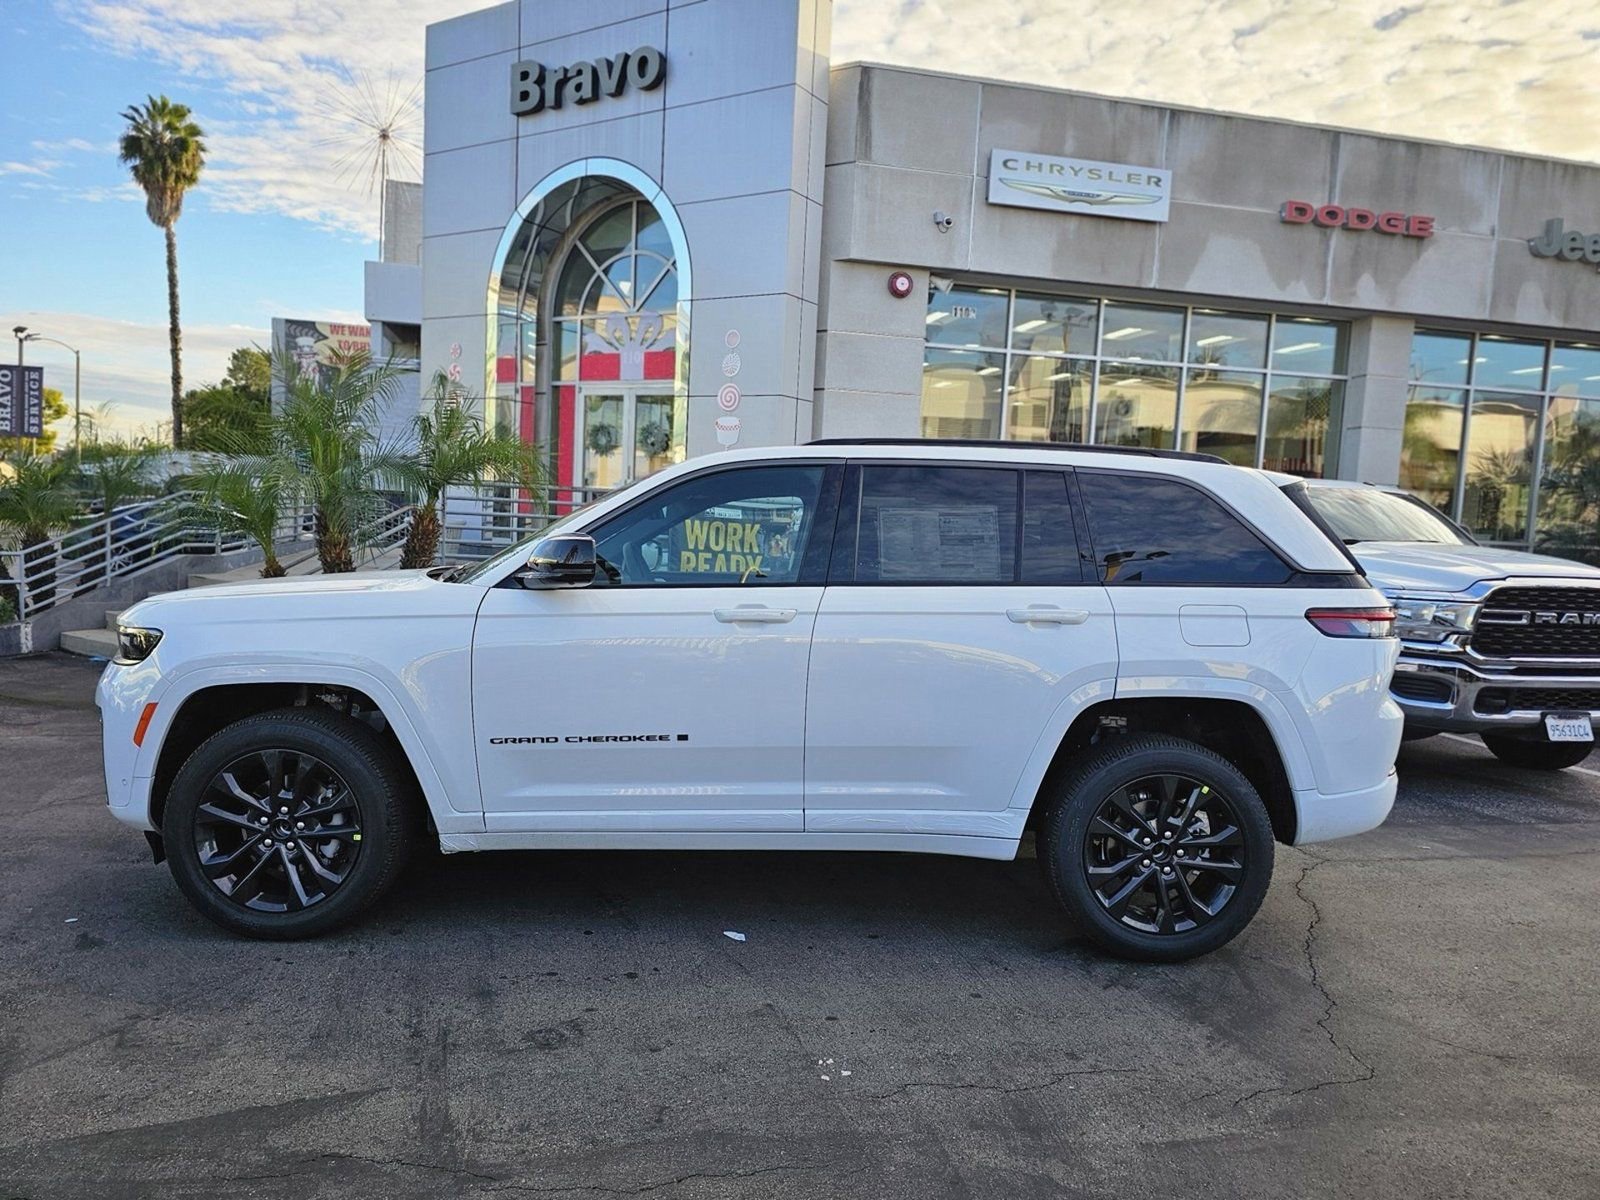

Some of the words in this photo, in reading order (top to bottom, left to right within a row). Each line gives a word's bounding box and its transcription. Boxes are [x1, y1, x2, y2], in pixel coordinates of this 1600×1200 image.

[511, 46, 667, 115] Bravo
[1002, 158, 1163, 188] CHRYSLER
[1280, 200, 1435, 238] DODGE
[329, 324, 346, 336] WE
[0, 369, 11, 432] BRAVO
[29, 371, 40, 434] SERVICE
[685, 519, 761, 553] WORK
[1535, 612, 1600, 624] RAM
[564, 734, 670, 743] CHEROKEE
